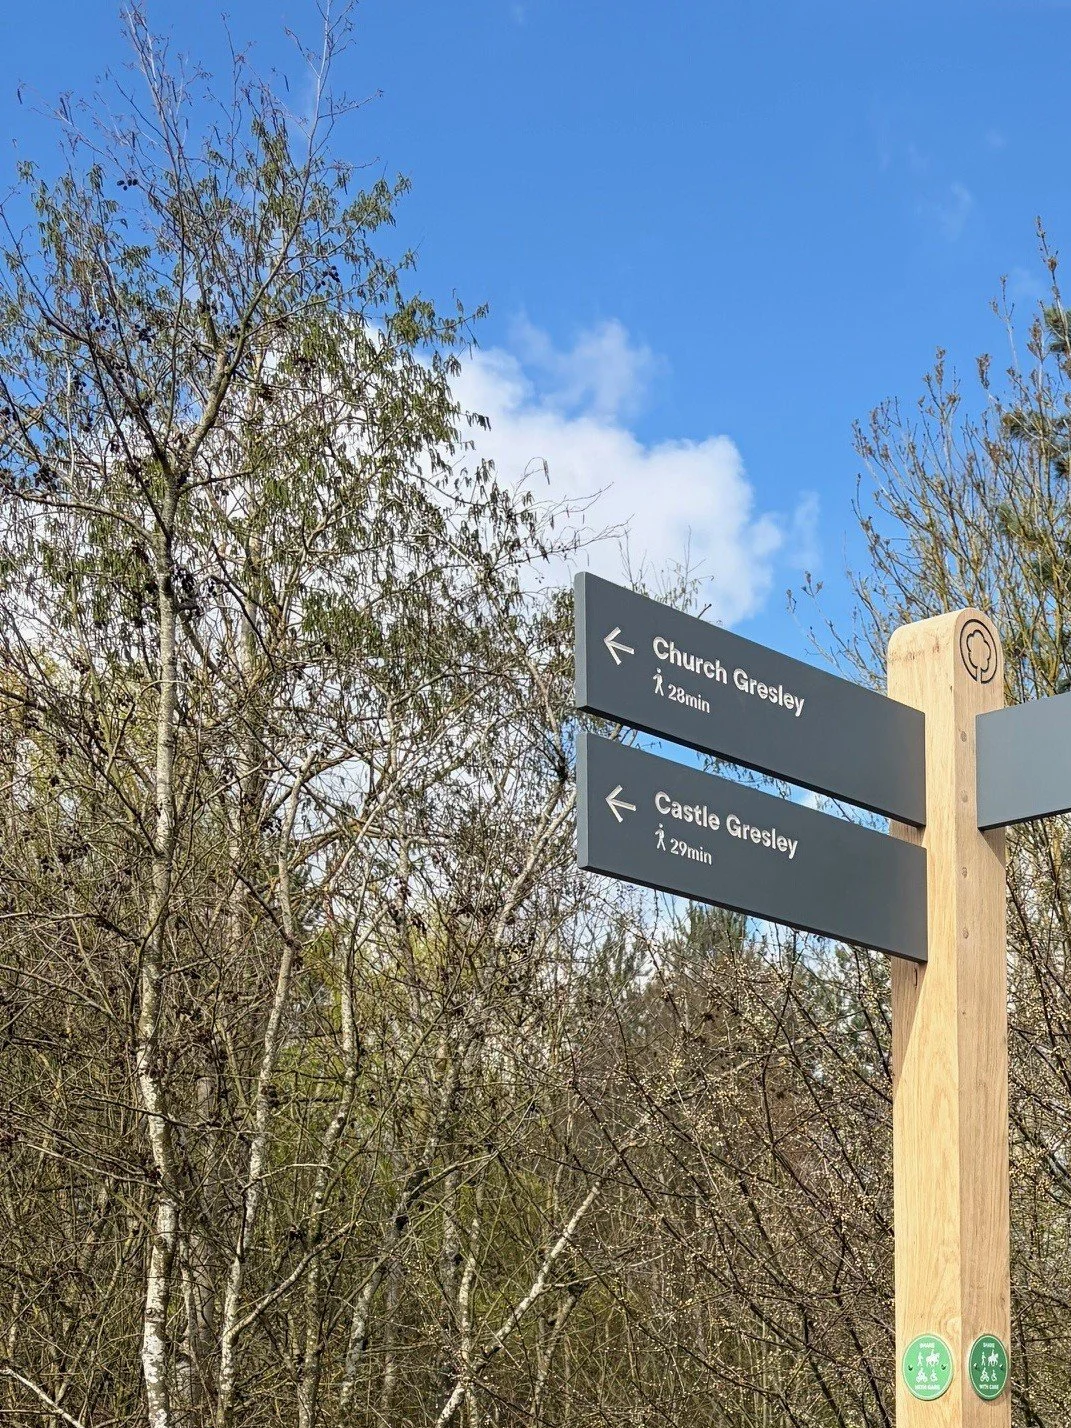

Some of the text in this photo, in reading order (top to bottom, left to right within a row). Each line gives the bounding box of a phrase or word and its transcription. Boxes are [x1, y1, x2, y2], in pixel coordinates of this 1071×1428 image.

[652, 636, 804, 717] Church Gresley
[667, 684, 710, 713] 28min
[654, 791, 798, 859] Castle Gresley
[670, 838, 712, 865] 29min
